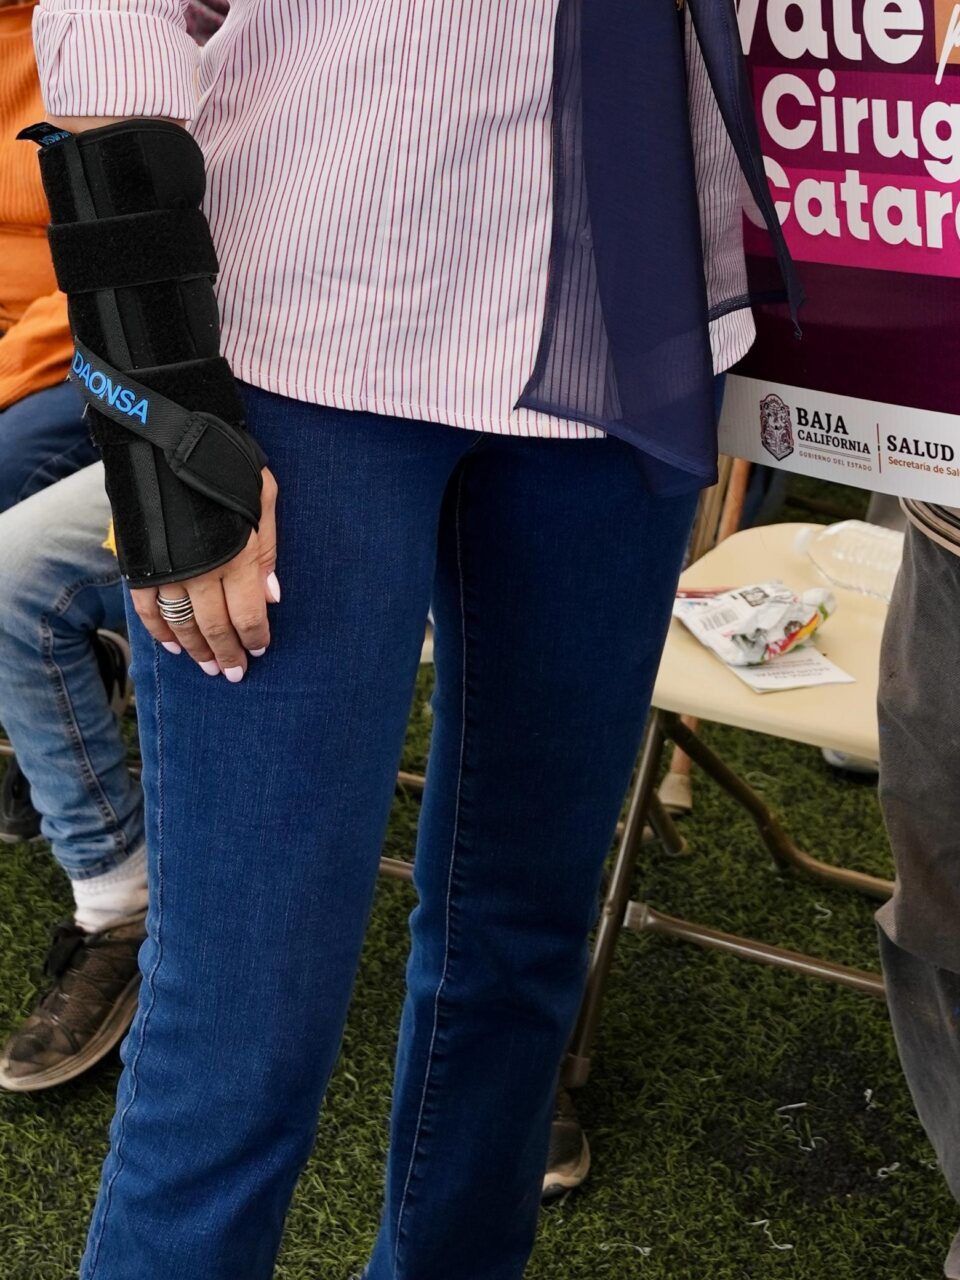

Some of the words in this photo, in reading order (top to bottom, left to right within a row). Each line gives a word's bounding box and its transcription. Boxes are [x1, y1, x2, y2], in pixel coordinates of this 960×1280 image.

[72, 350, 149, 425] DAONSA
[796, 407, 849, 435] BAJA
[797, 430, 871, 454] CALIFORNIA
[887, 435, 954, 462] SALUD
[799, 450, 832, 463] GOBIERNO
[833, 458, 845, 466] DEL
[847, 460, 872, 471] ESTADO
[933, 465, 944, 474] de
